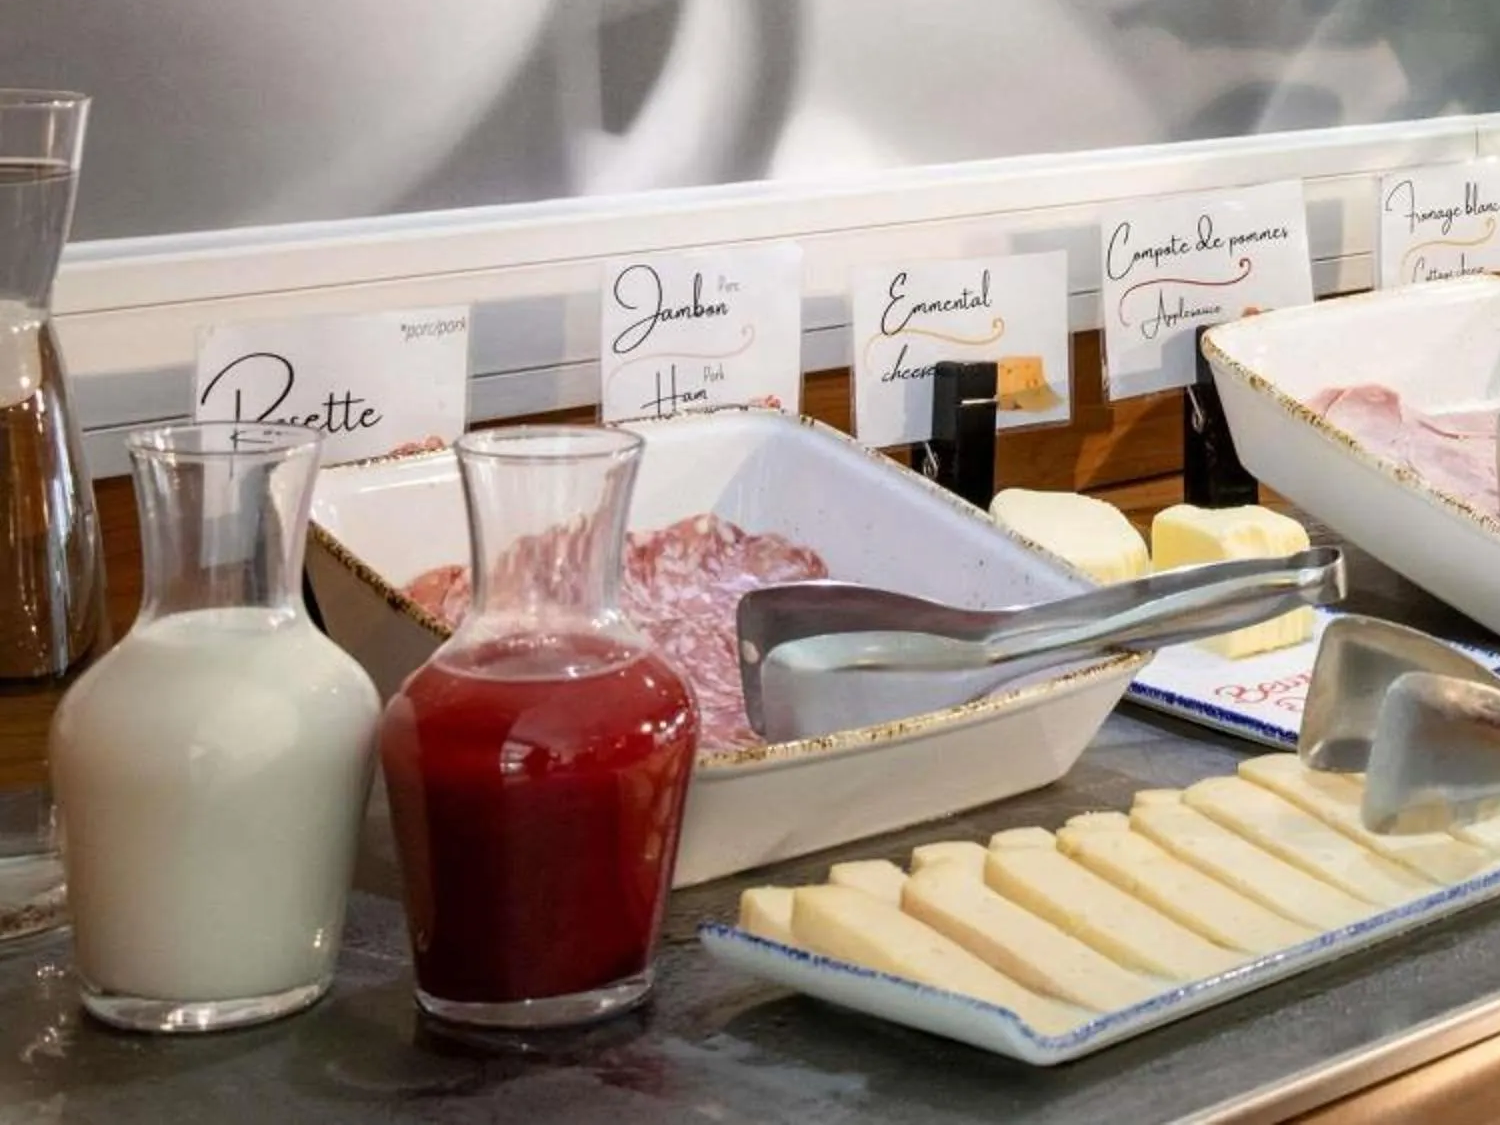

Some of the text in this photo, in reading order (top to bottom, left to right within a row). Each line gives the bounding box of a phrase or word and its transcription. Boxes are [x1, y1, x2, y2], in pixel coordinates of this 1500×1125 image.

[1465, 182, 1500, 216] blanc
[1106, 214, 1289, 281] Compote de pommes
[613, 264, 729, 354] Jambon
[881, 269, 992, 336] Emmental
[640, 364, 708, 416] Ham
